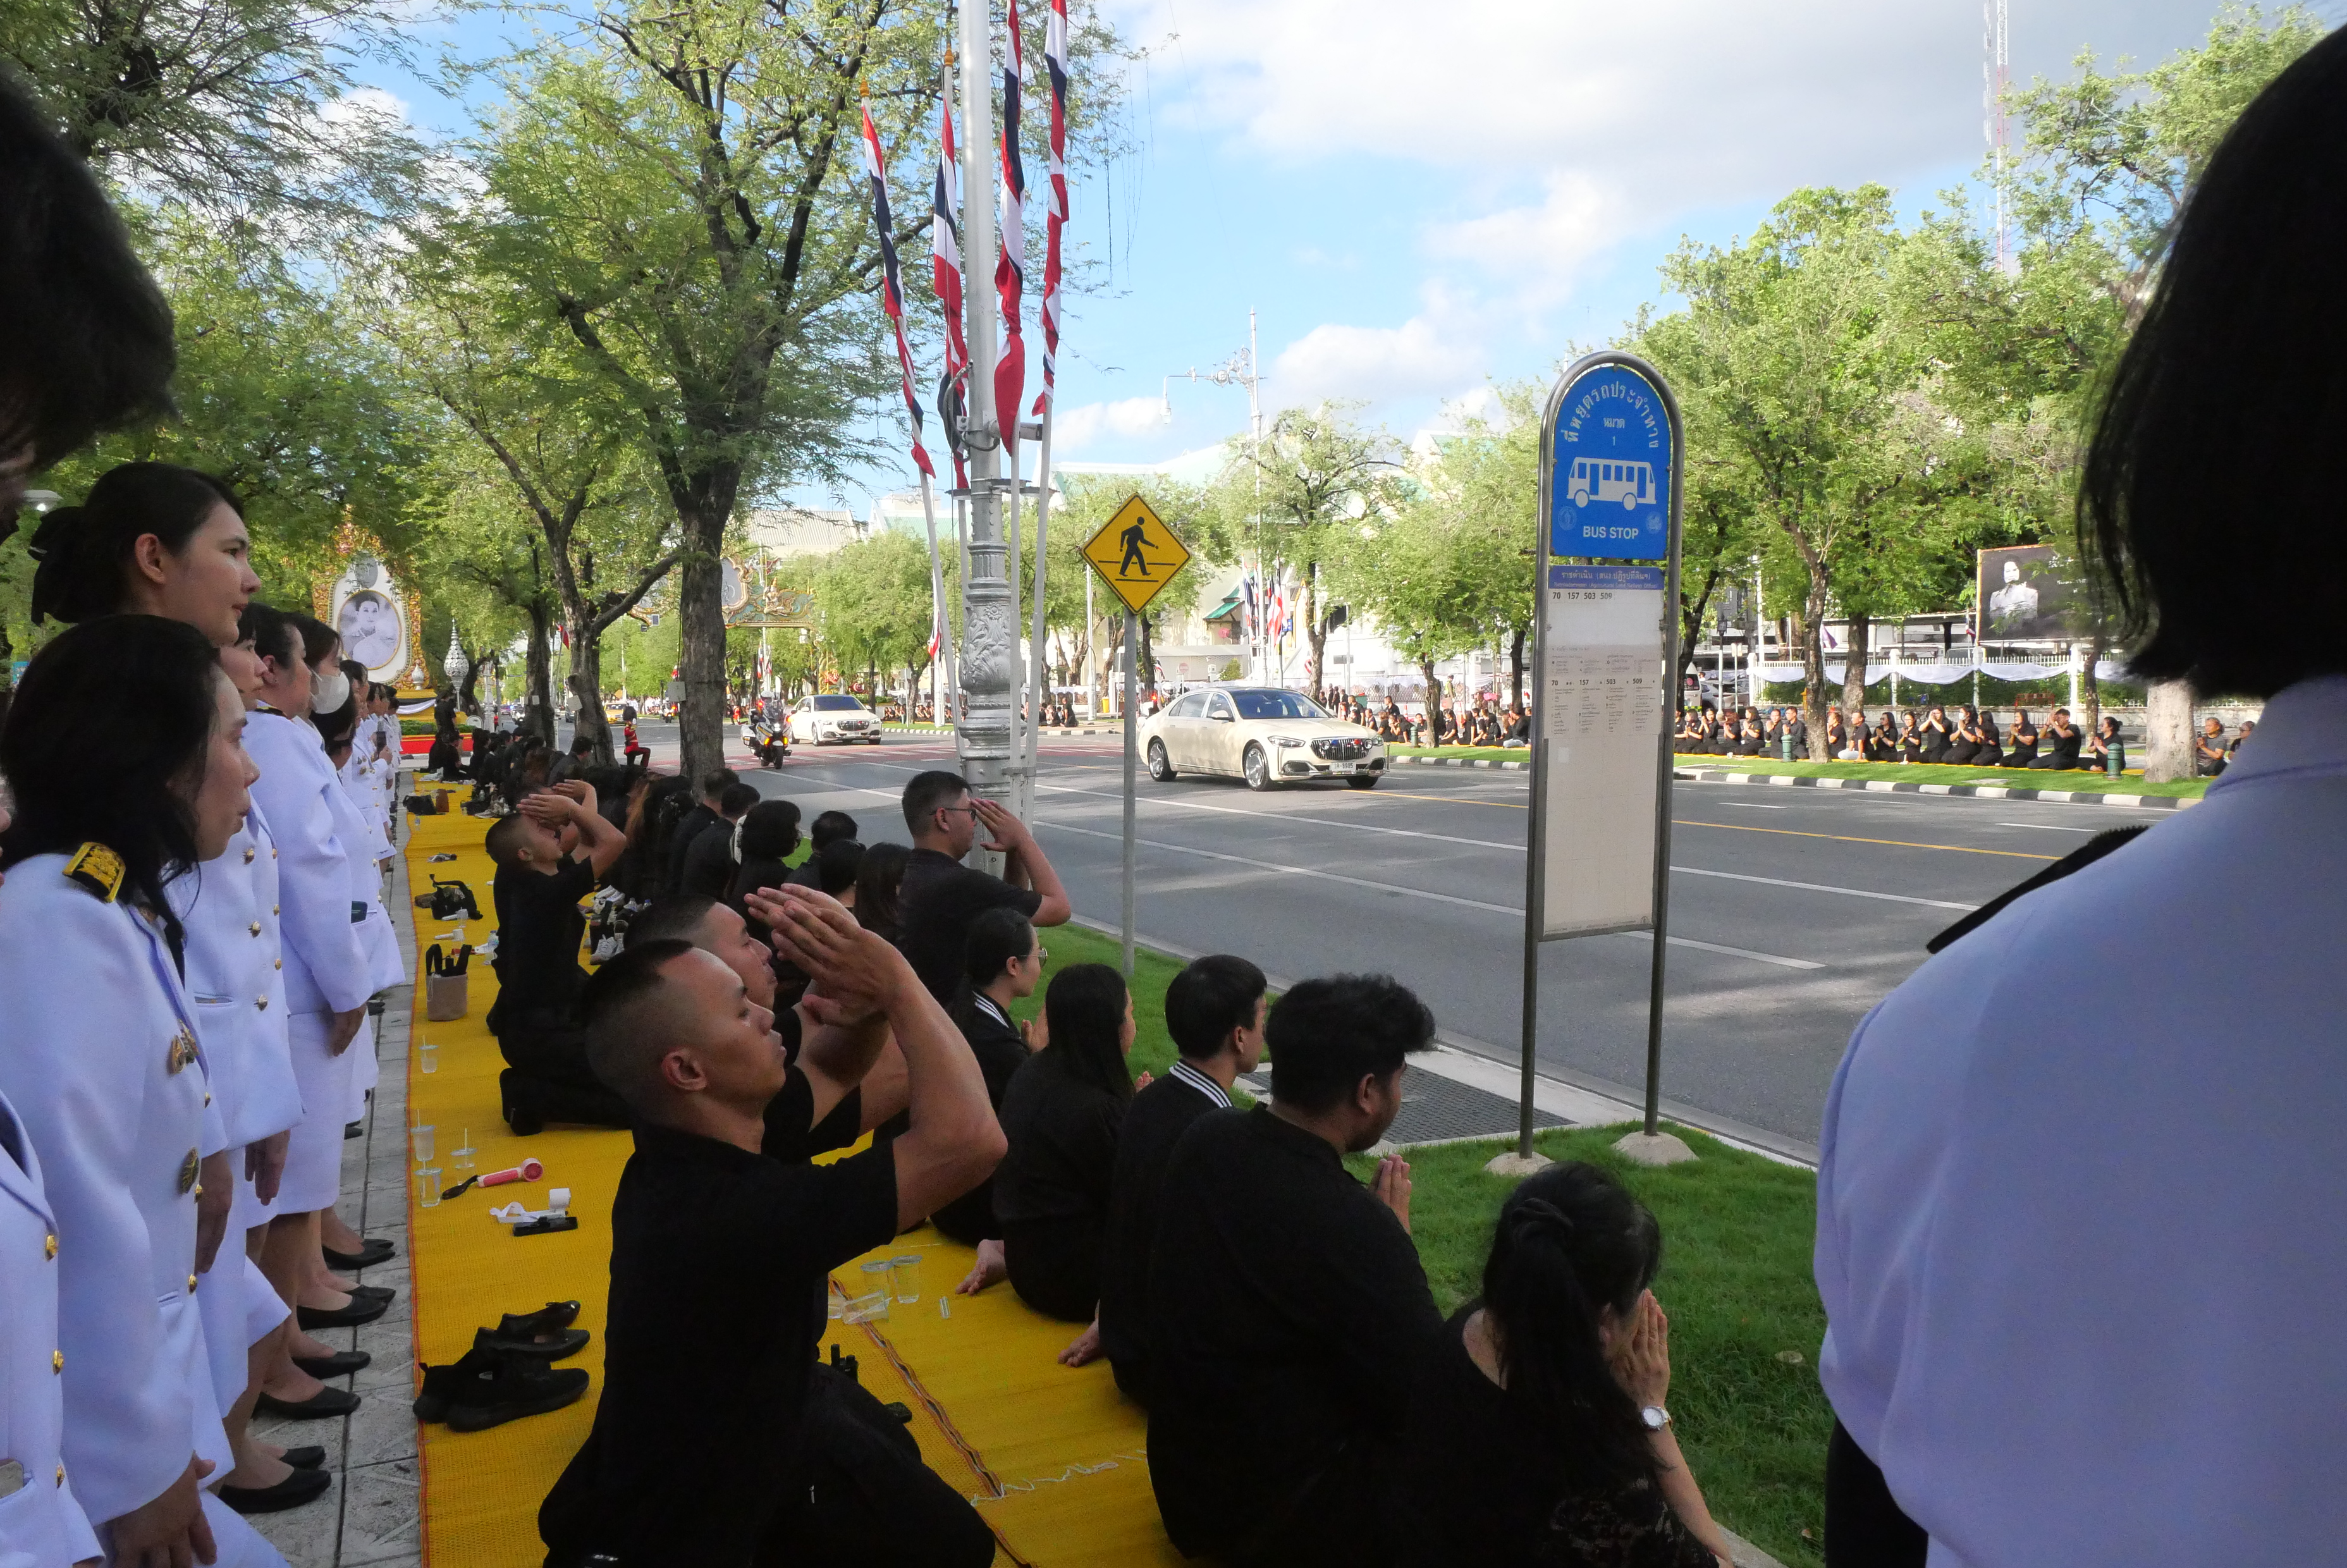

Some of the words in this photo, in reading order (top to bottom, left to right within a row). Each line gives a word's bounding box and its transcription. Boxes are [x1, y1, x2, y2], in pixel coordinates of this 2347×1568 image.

[1560, 381, 1659, 448] ที่หยุดรถประจำทาง
[1603, 417, 1625, 429] หมวด
[1612, 436, 1615, 446] 1
[1583, 526, 1606, 538] BUS
[1610, 527, 1639, 539] STOP
